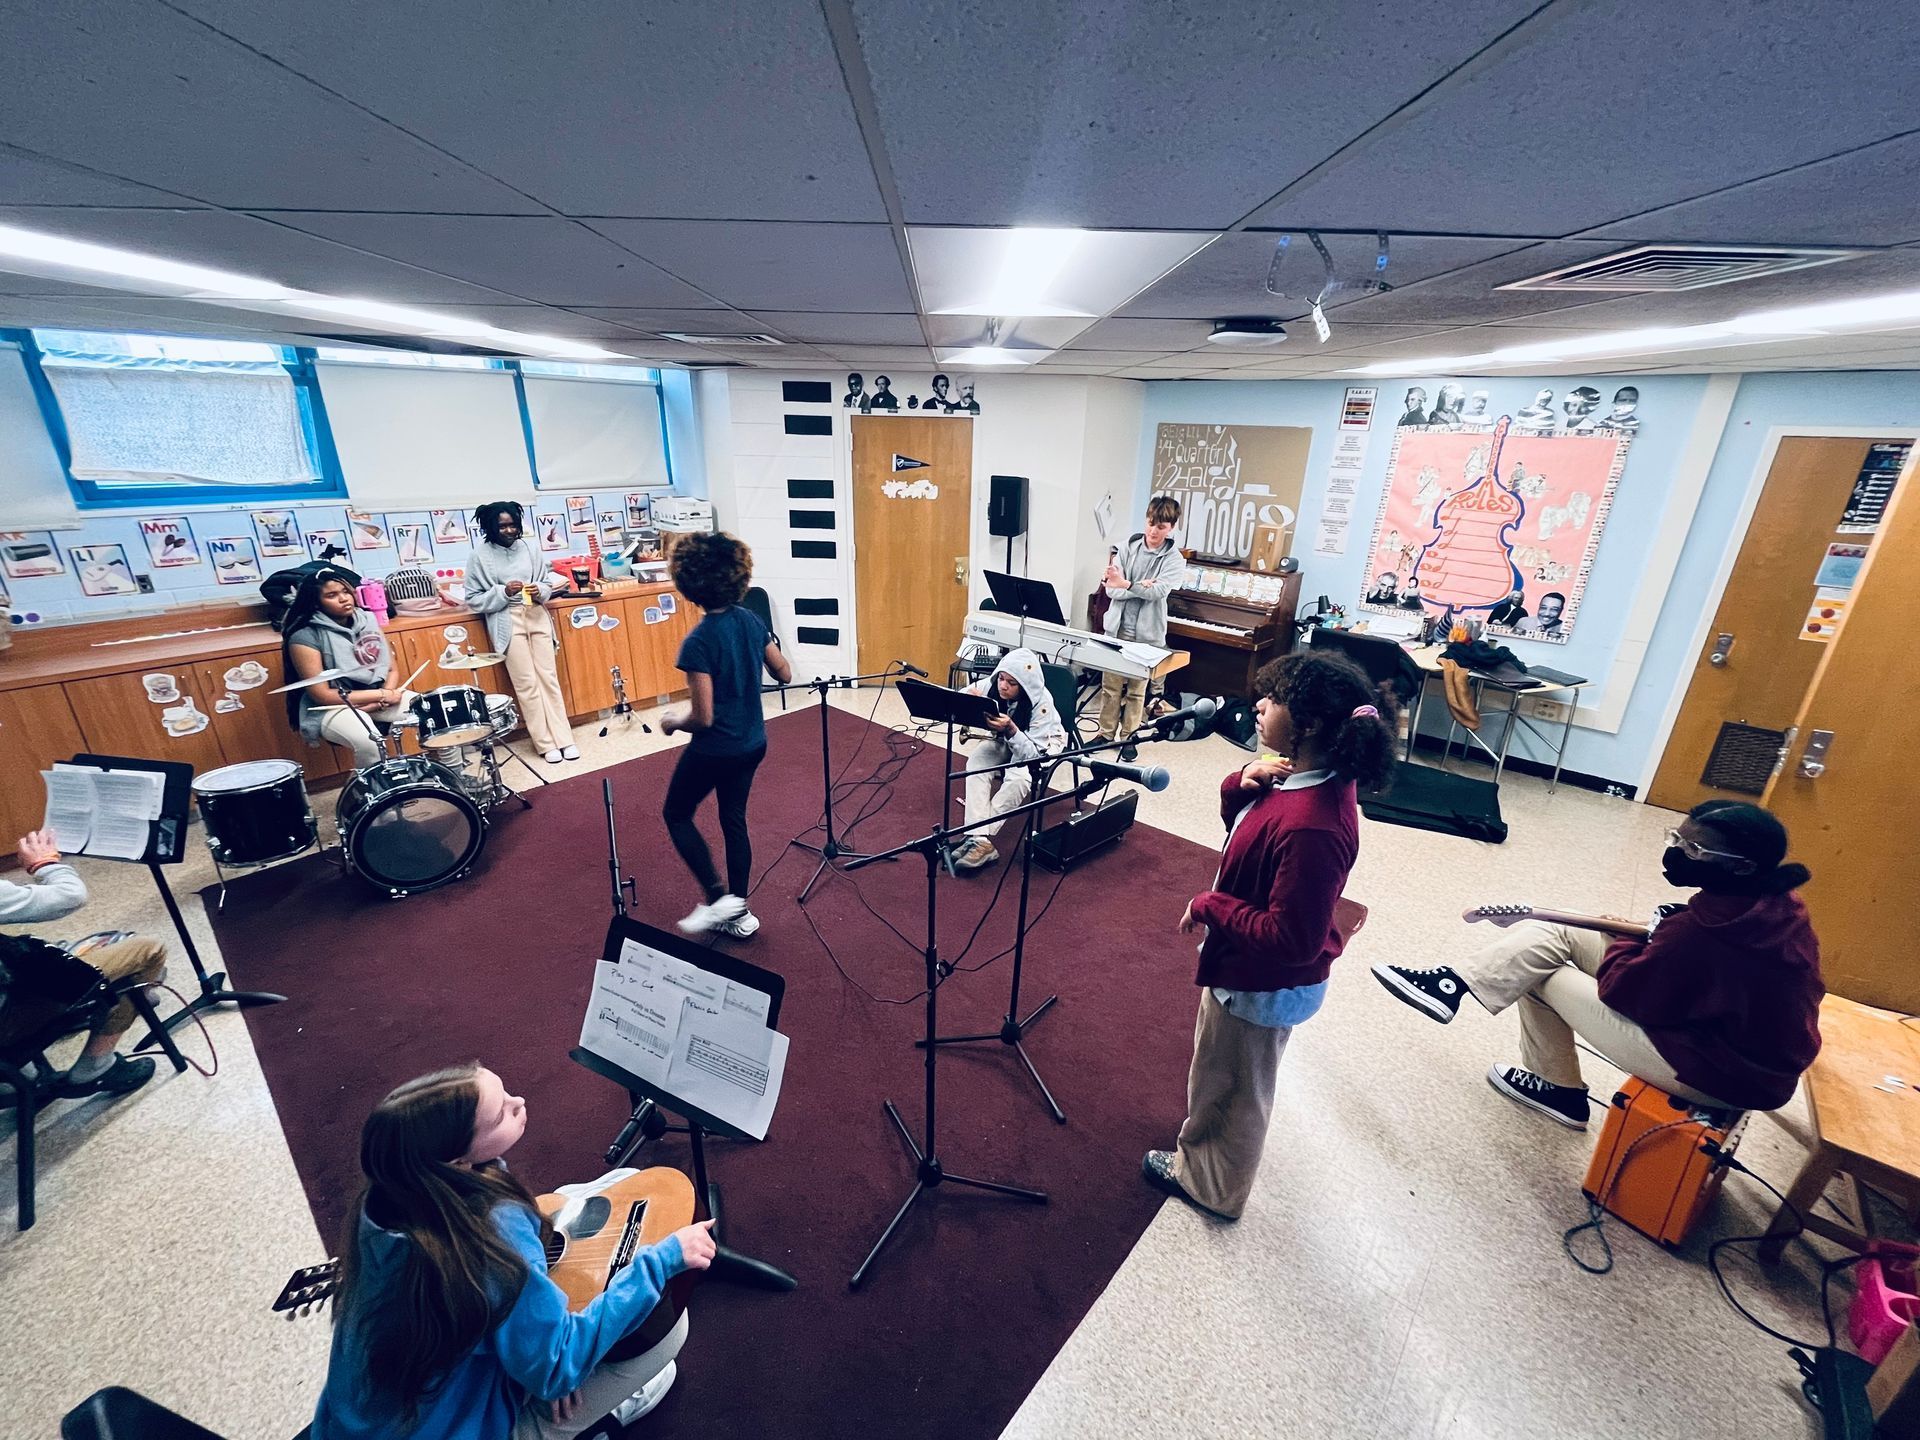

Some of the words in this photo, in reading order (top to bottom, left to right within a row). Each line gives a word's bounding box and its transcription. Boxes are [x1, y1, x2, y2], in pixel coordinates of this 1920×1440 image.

[1175, 443, 1223, 464] Quarter
[628, 496, 639, 505] Yy
[539, 517, 554, 526] Vv
[600, 514, 614, 522] Xx
[144, 523, 179, 534] Mm
[397, 528, 411, 537] Rr
[309, 534, 327, 546] Pp
[211, 542, 235, 552] Nn
